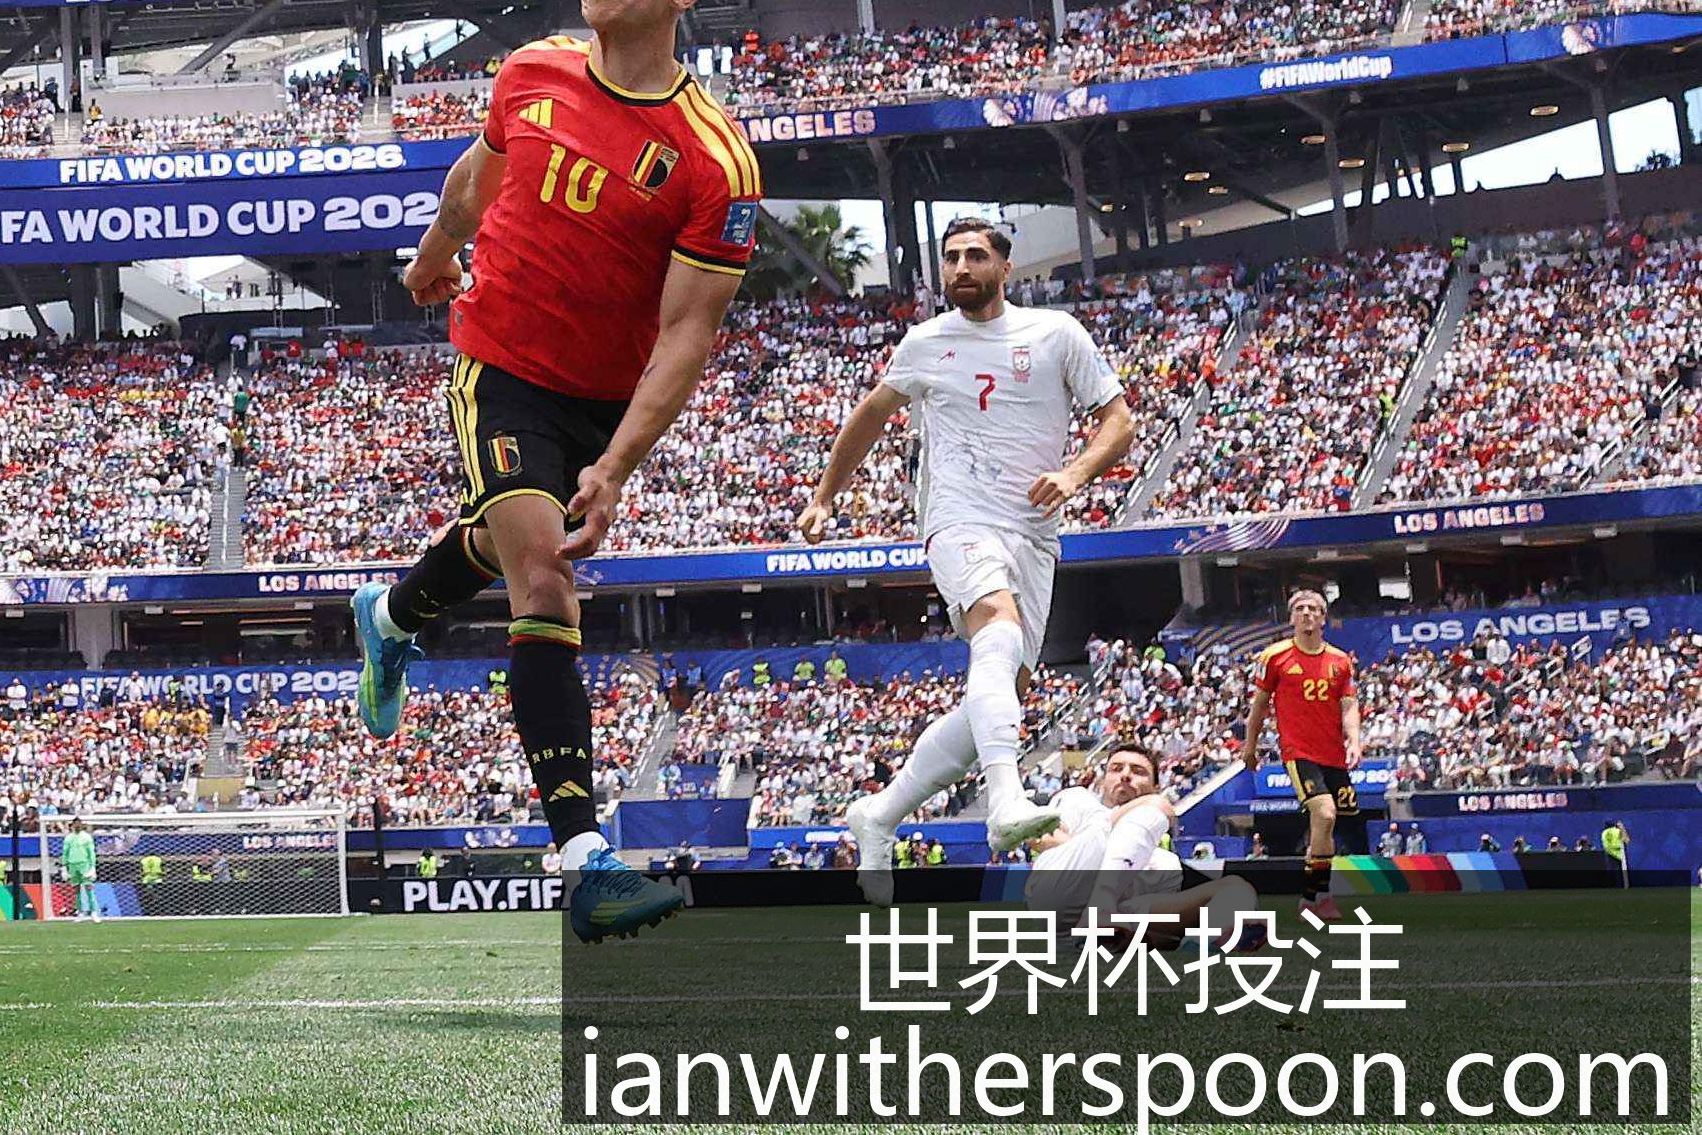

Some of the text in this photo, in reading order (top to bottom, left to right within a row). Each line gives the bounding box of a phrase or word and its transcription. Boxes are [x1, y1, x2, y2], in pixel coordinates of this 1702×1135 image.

[1260, 56, 1392, 89] #FIFAWorldCup
[59, 145, 405, 184] FIFA WORLD CUP 2026
[540, 142, 609, 214] 10
[57, 204, 220, 241] WORLD
[227, 198, 316, 237] CUP
[975, 374, 996, 411] 7
[1394, 503, 1545, 534] LOS ANGELES
[766, 553, 811, 572] FIFA
[811, 550, 886, 571] WORLD
[259, 575, 300, 592] LOS
[1392, 619, 1465, 644] LOS
[236, 672, 288, 693] CUP
[1303, 679, 1329, 701] 22
[1459, 792, 1568, 812] LOS ANGELES
[403, 879, 570, 912] PLAY.FIF
